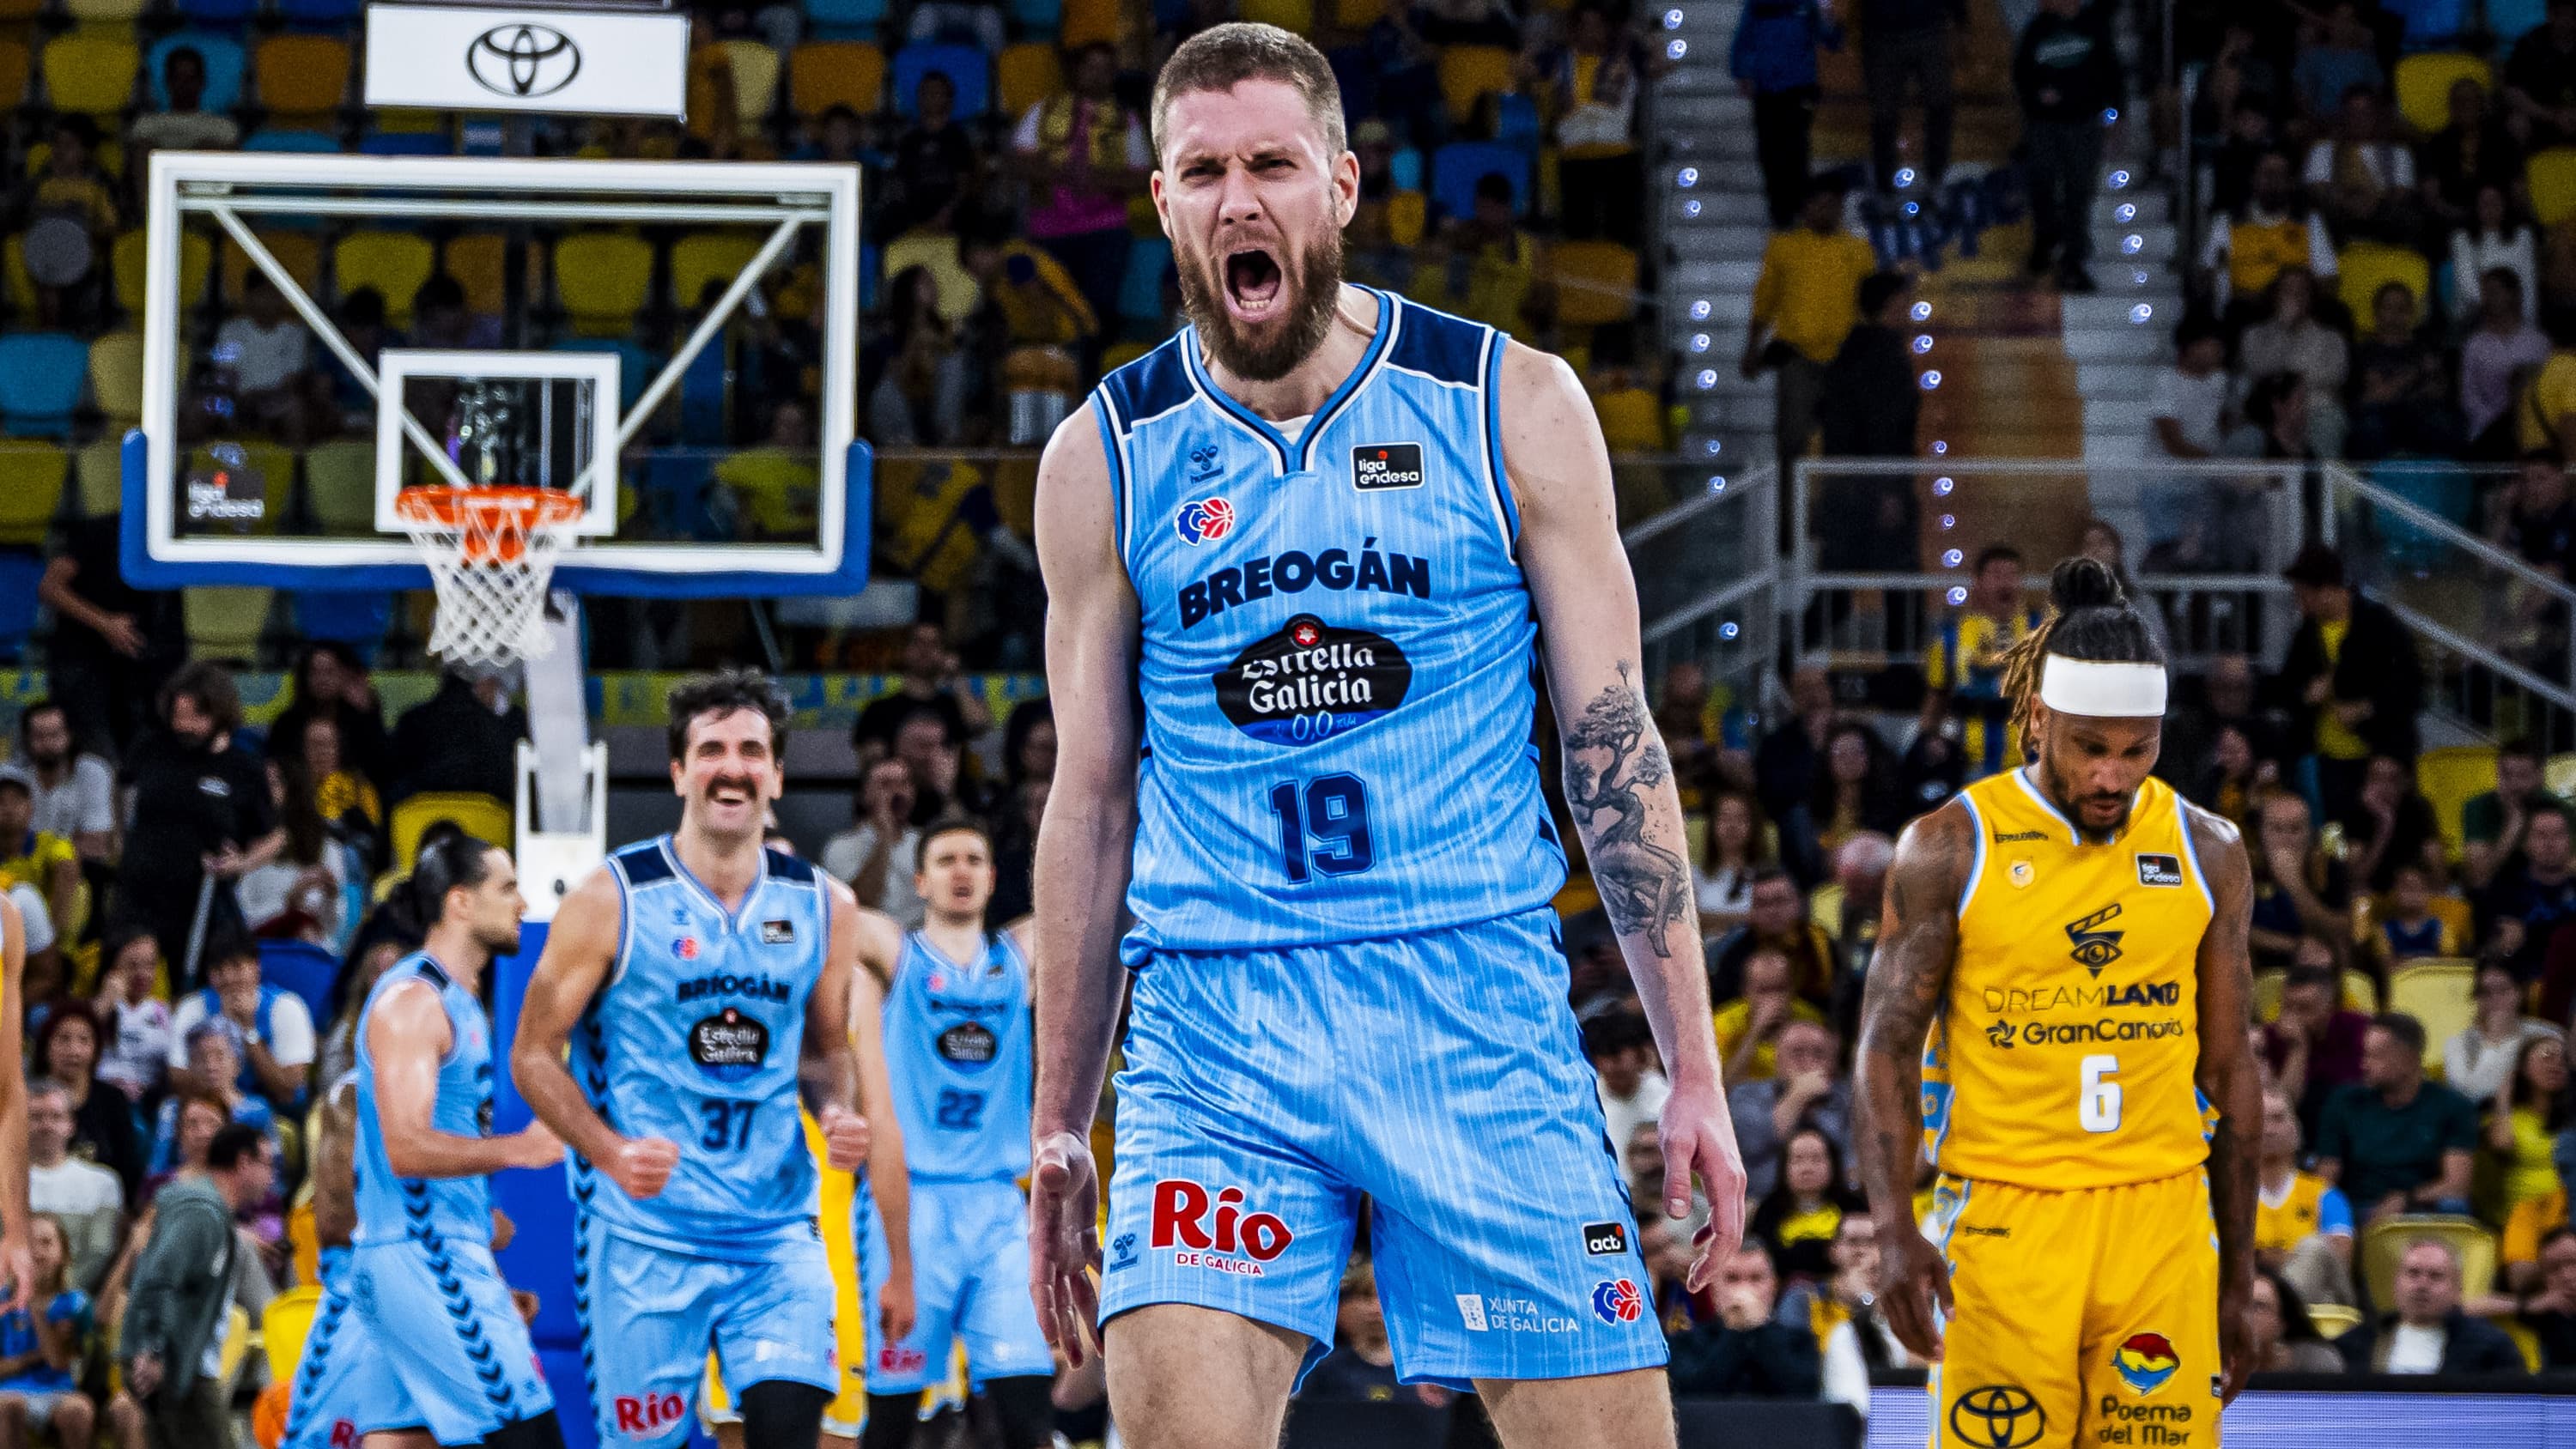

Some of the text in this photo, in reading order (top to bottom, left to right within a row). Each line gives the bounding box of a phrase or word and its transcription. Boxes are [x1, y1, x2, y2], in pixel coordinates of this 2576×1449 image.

[1358, 458, 1387, 473] liga
[1359, 470, 1419, 485] endesa
[1178, 537, 1431, 630] BREOGÁN
[1249, 671, 1373, 713] Galicia
[1268, 771, 1376, 885] 19
[1984, 980, 2181, 1013] DREAMLAND
[2080, 1054, 2123, 1133] 6
[701, 1098, 760, 1152] 37
[938, 1089, 985, 1133] 22
[1589, 1234, 1621, 1252] acb
[1176, 1252, 1263, 1276] DE GALICIA
[1488, 1297, 1539, 1314] XUNTA
[1491, 1314, 1579, 1333] DE GALICIA
[2100, 1394, 2192, 1422] Poema
[2099, 1423, 2190, 1446] del Mar
